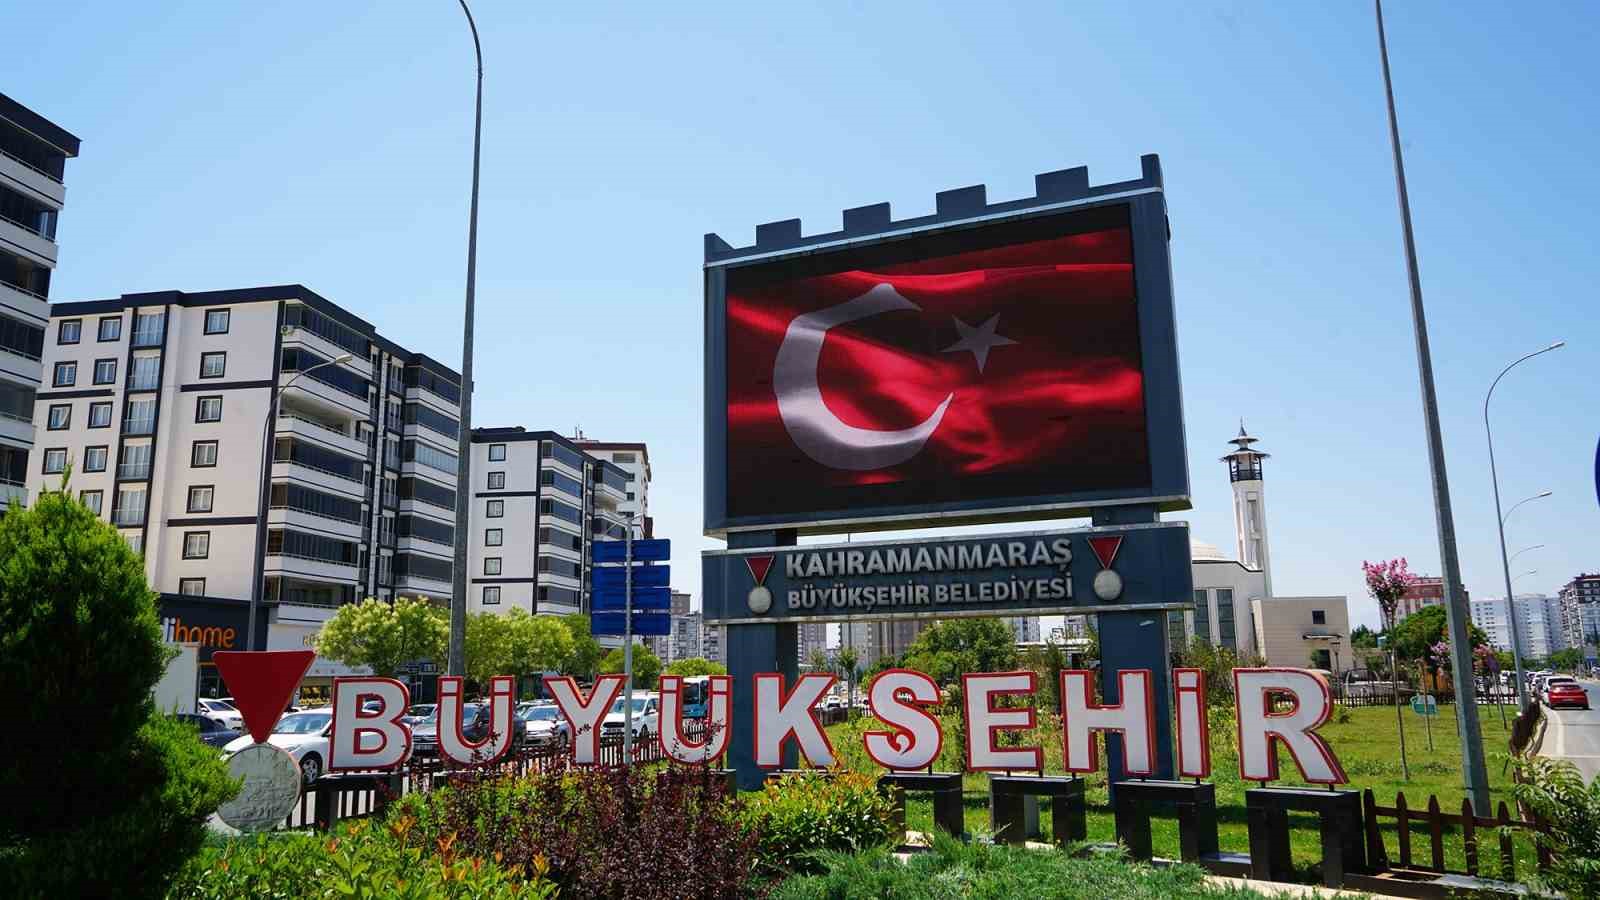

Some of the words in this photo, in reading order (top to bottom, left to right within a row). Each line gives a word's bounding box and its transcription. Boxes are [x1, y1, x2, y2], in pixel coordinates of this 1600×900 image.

[785, 538, 1073, 577] KAHRAMANMARAŞ
[786, 581, 930, 611] BÜYÜKŞEHİR
[934, 575, 1074, 604] BELEDİYESİ
